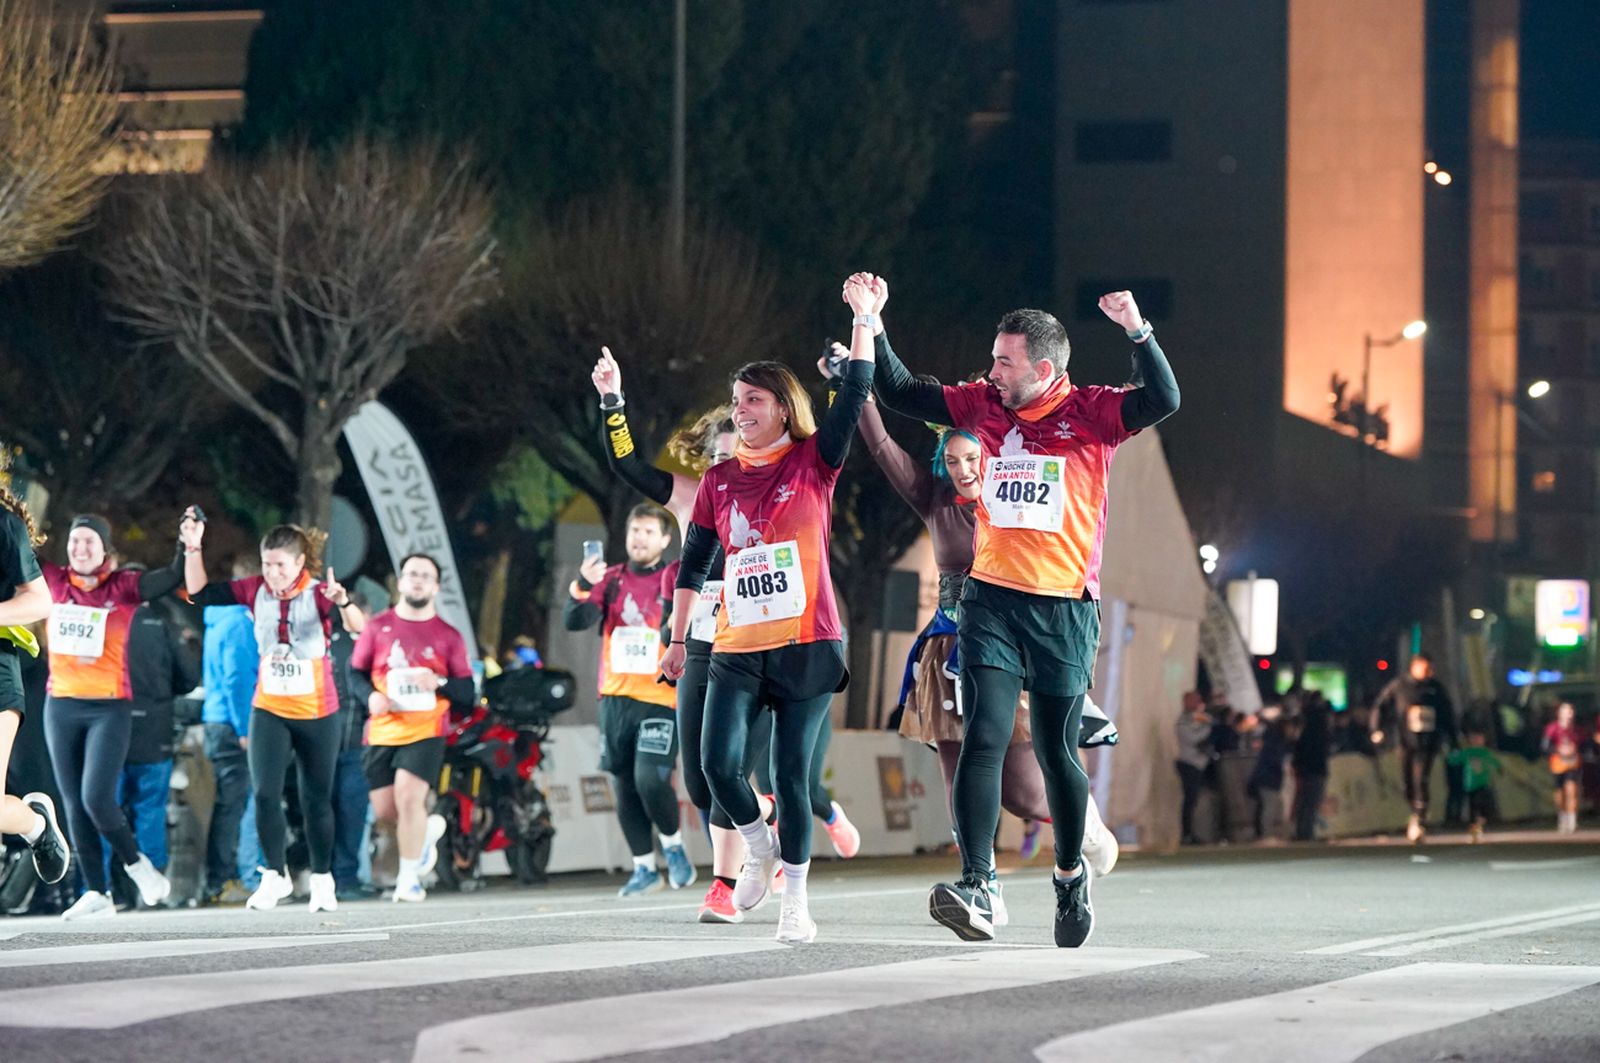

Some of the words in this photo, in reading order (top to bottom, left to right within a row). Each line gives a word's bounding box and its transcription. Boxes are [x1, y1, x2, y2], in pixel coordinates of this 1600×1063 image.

[1003, 463, 1026, 471] NOCHE
[993, 472, 1008, 480] SAN
[995, 481, 1050, 505] 4082
[389, 441, 461, 609] JAEMASA
[758, 554, 768, 563] DE
[736, 571, 788, 598] 4083
[59, 622, 94, 639] 5992
